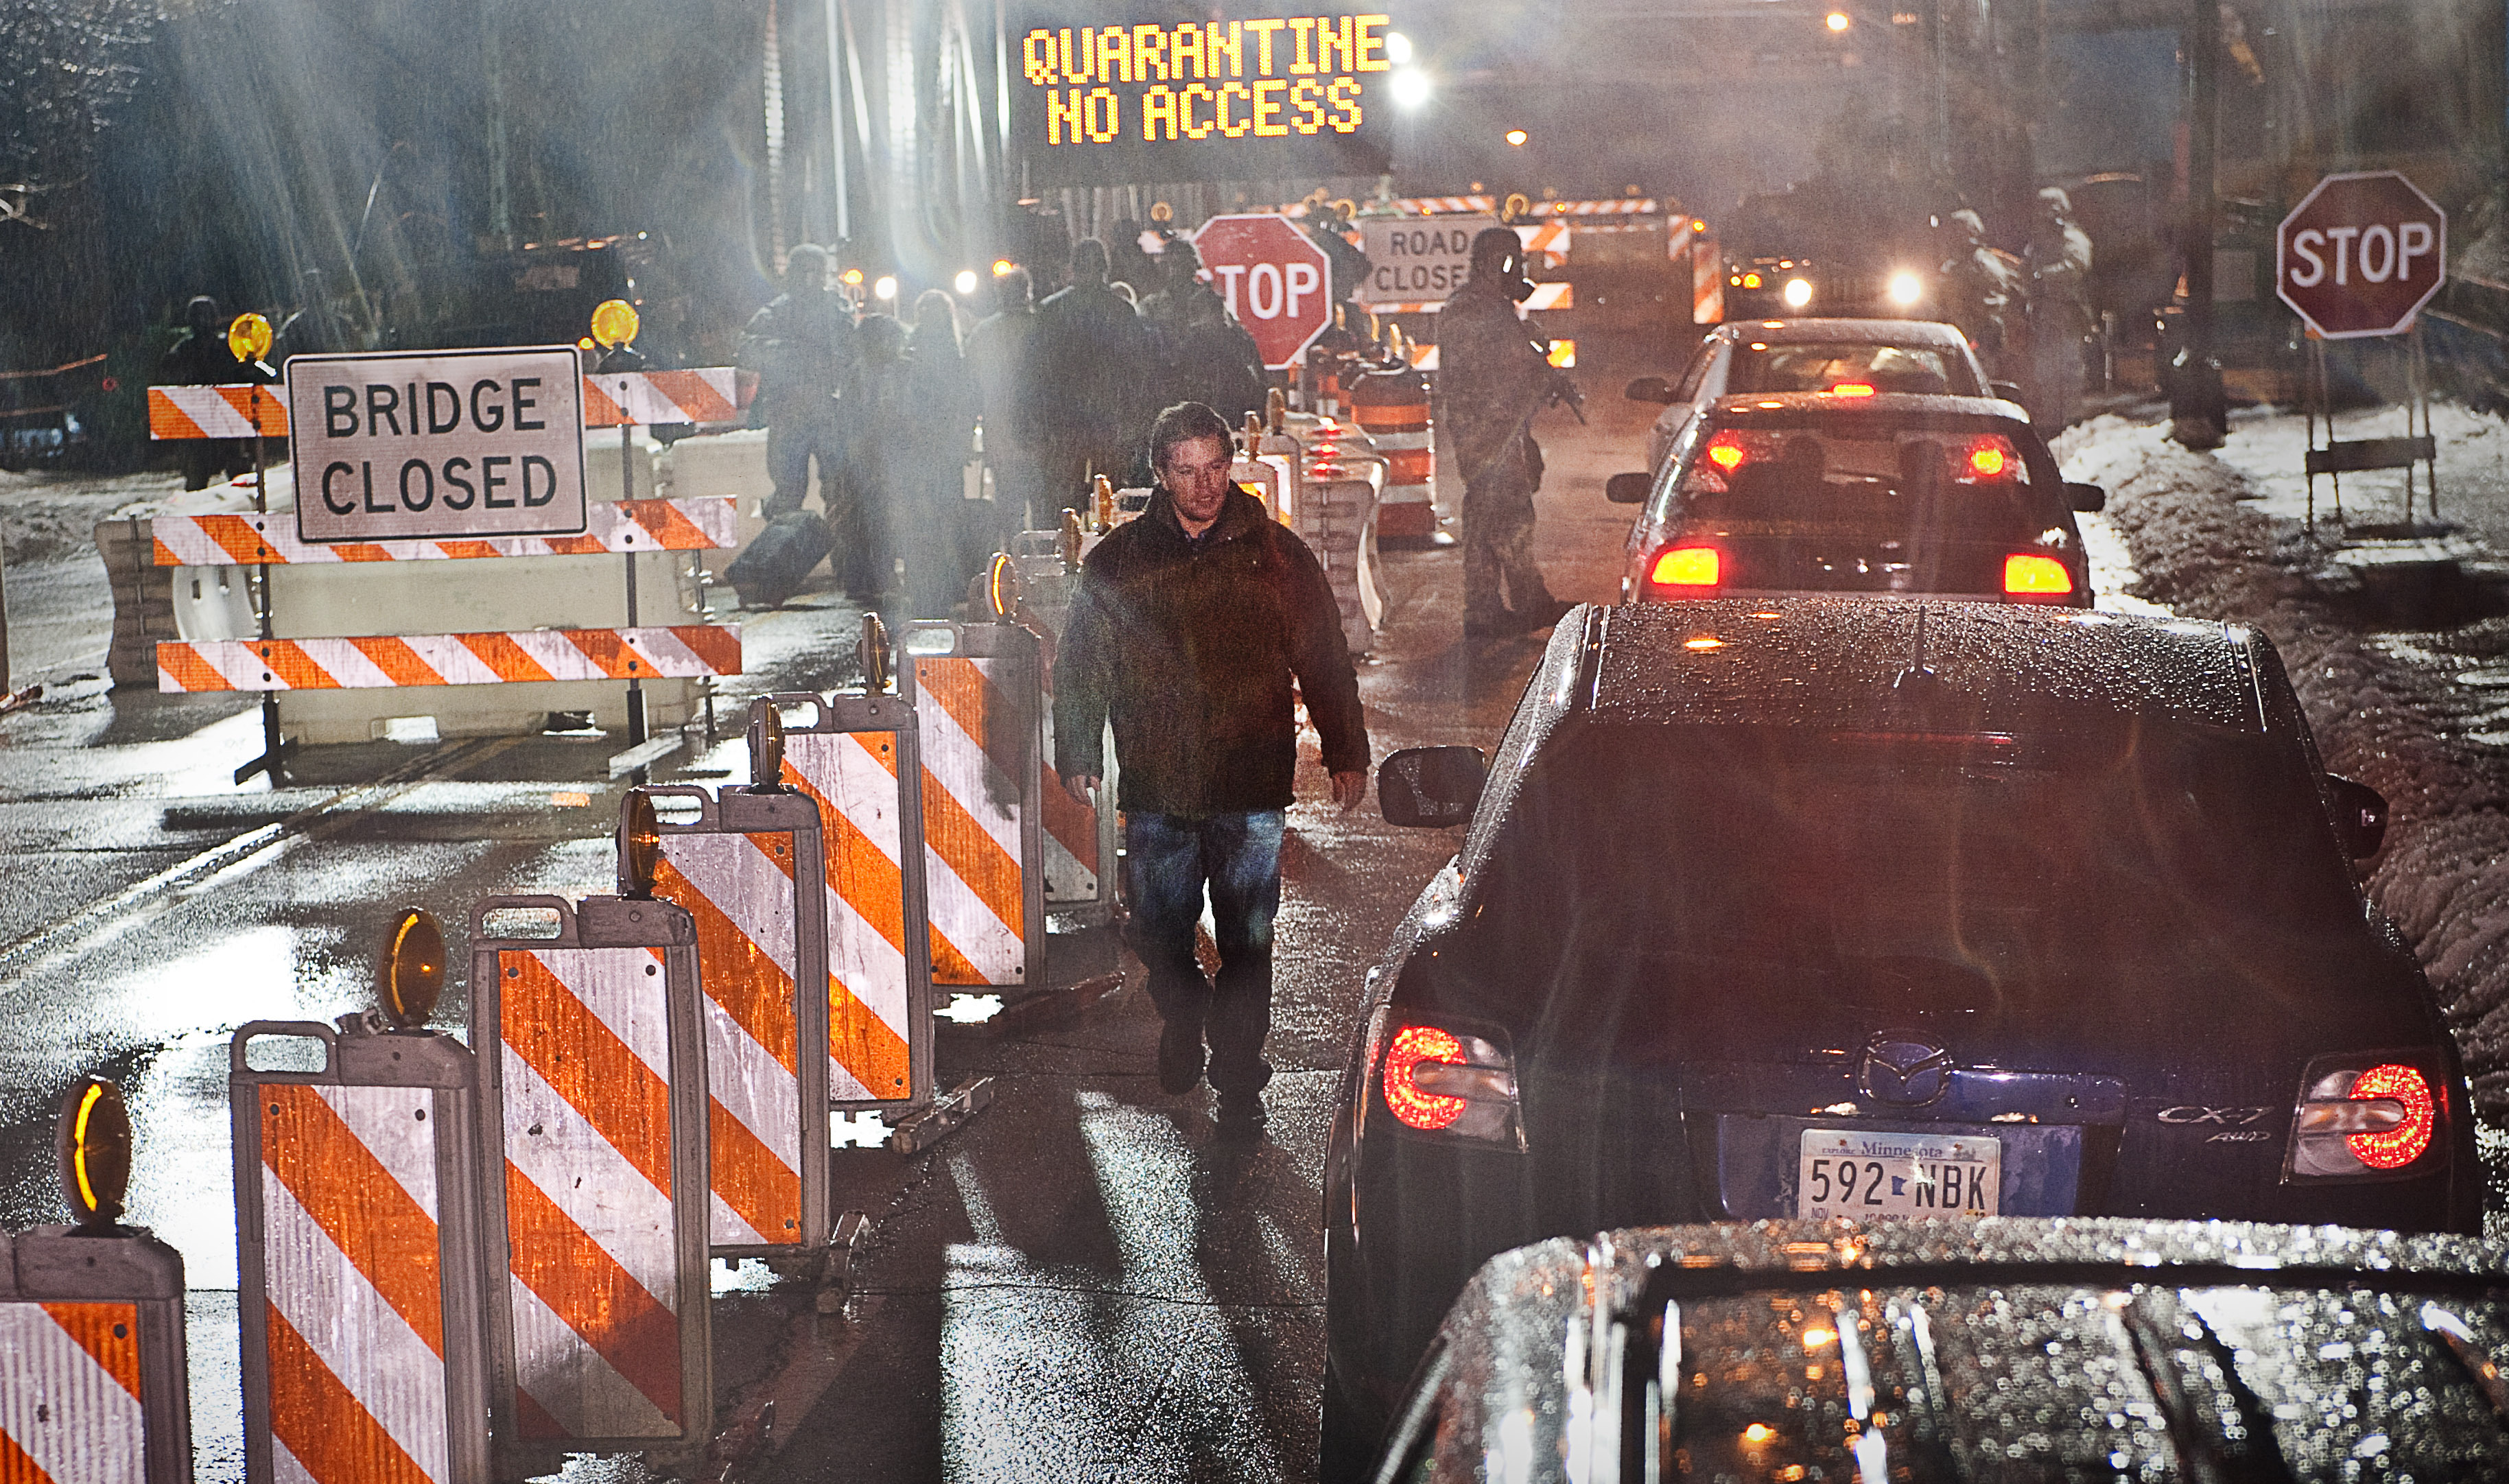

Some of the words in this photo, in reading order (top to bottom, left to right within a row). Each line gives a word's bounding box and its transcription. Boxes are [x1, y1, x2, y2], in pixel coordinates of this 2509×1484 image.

[1023, 14, 1391, 85] QUARANTINE
[1048, 87, 1119, 145] NO
[1143, 77, 1363, 141] ACCESS
[1390, 230, 1469, 256] ROAD
[2290, 222, 2433, 287] STOP
[1195, 263, 1320, 320] TOP
[1374, 264, 1468, 291] CLOSE
[324, 377, 545, 438] BRIDGE
[322, 456, 556, 515] CLOSED
[2158, 1106, 2274, 1124] CX-7
[2205, 1131, 2271, 1143] AWD
[1811, 1159, 1884, 1205] 592
[1916, 1164, 1987, 1210] NBK
